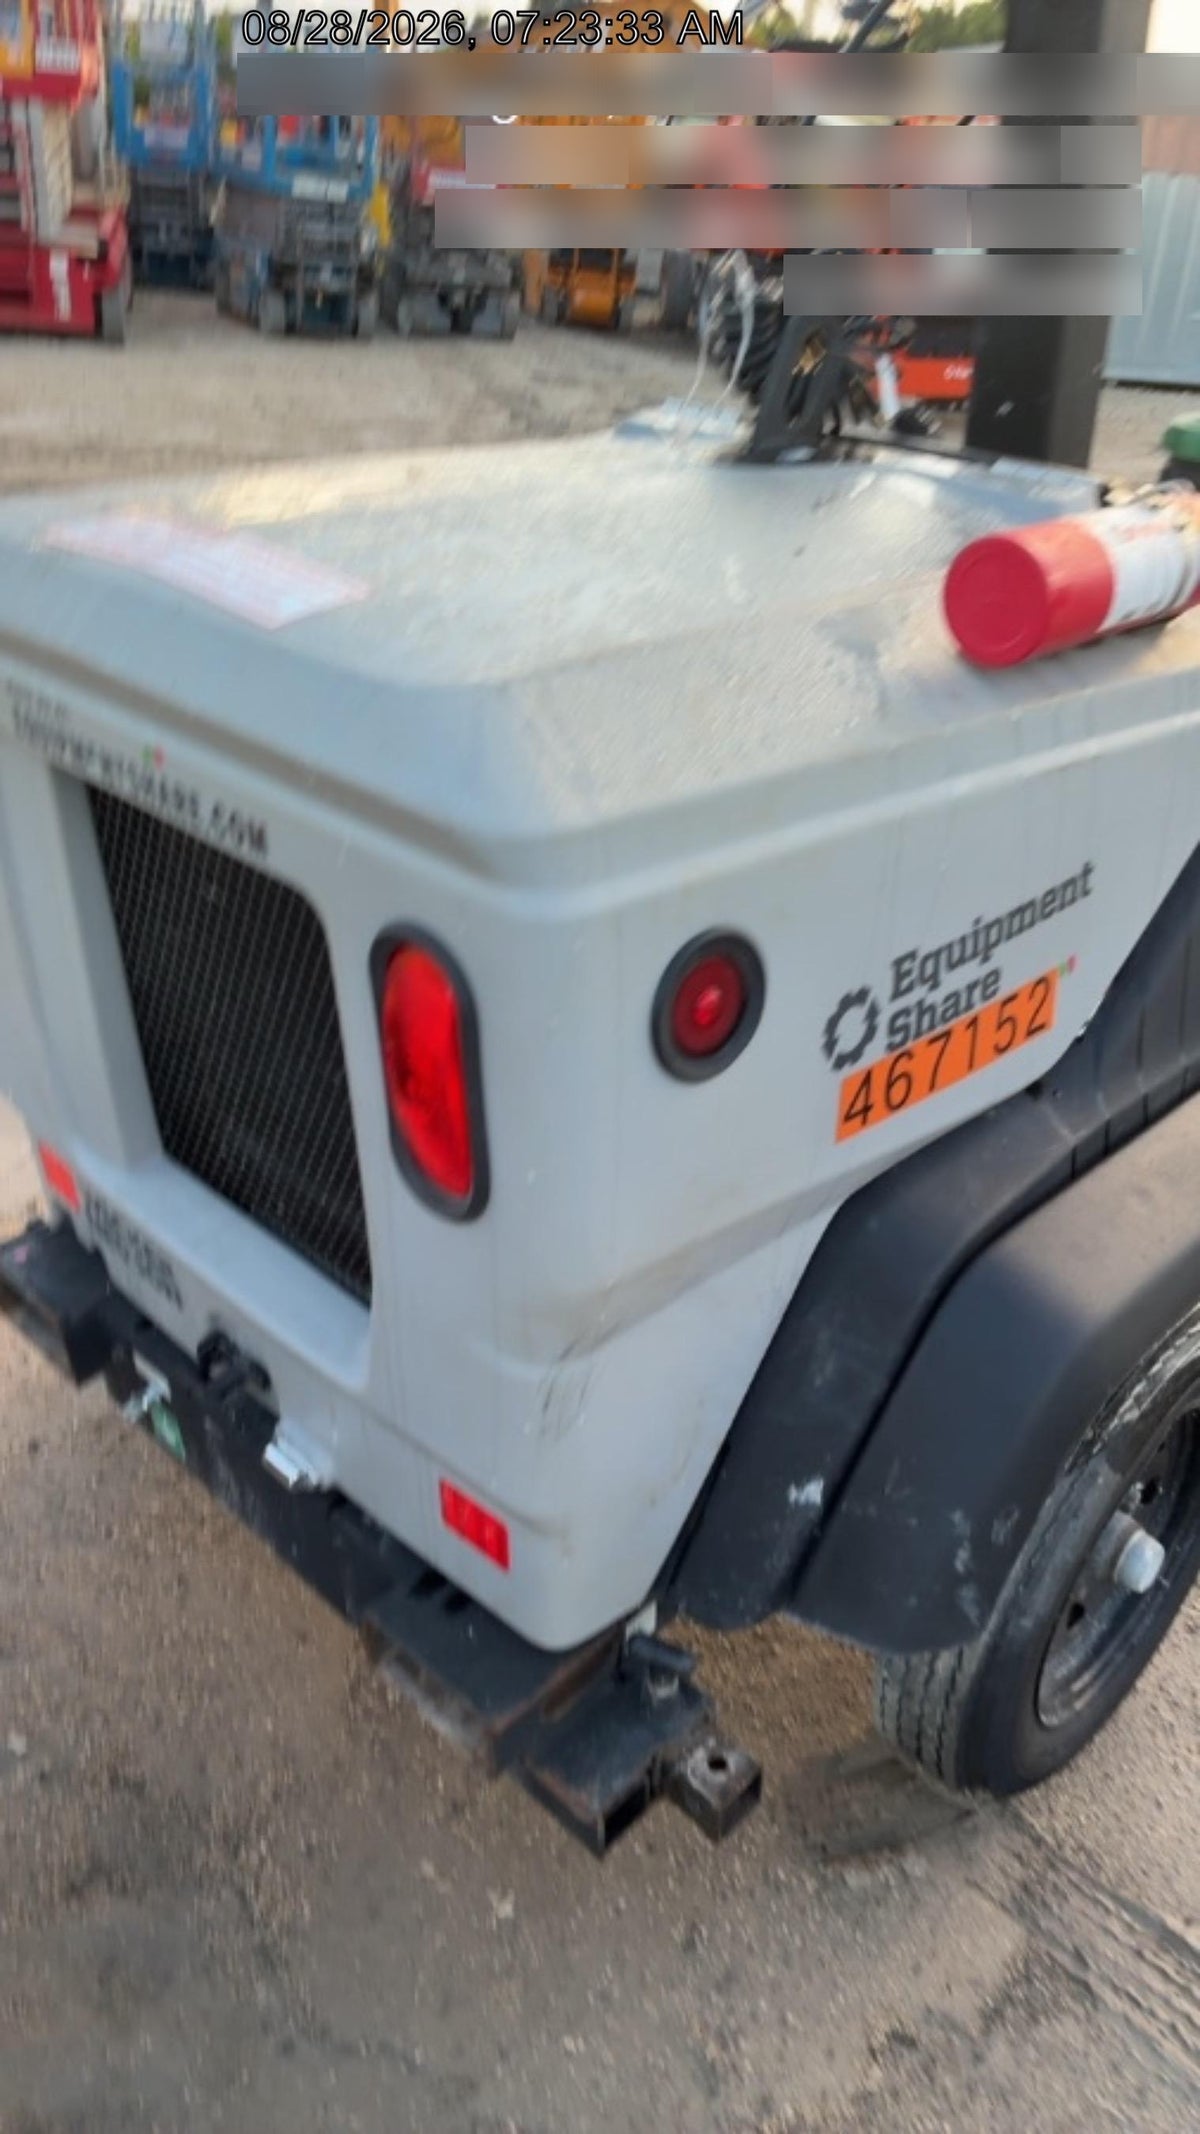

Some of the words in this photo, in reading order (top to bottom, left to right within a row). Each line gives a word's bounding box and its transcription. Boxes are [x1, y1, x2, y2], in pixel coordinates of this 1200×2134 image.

[888, 860, 1096, 1003] Equipment
[843, 975, 1051, 1127] 467152
[885, 965, 1001, 1053] Share
